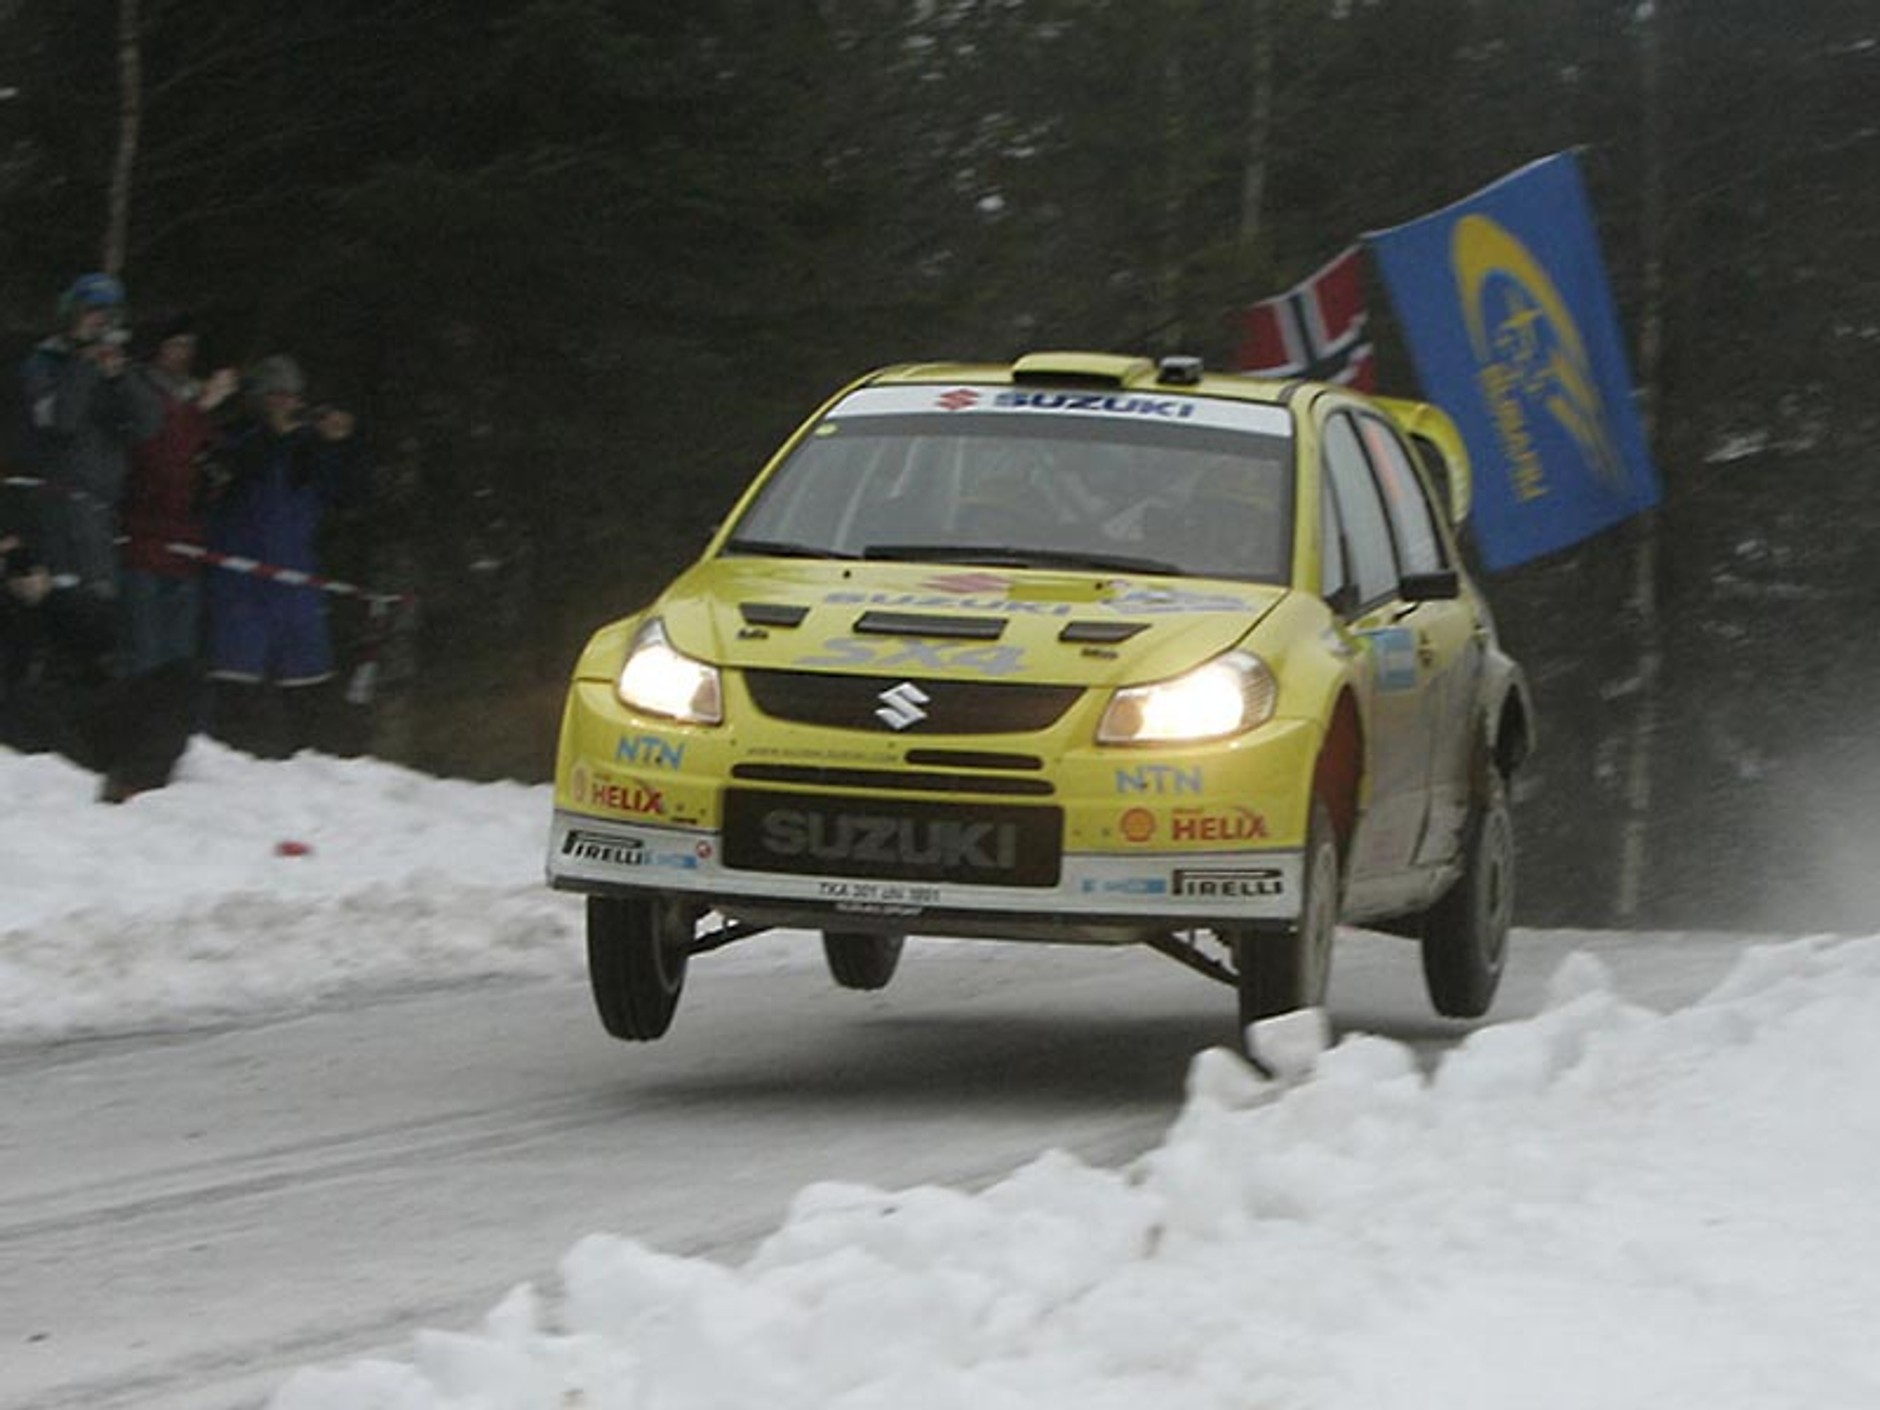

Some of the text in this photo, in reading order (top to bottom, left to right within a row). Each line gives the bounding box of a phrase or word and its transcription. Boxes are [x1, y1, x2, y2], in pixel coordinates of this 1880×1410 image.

[994, 391, 1195, 418] SUZUKI
[823, 592, 1070, 615] SUZUKI
[792, 635, 1031, 675] SX4
[615, 735, 686, 771] NTN
[592, 778, 667, 815] HELIX
[1116, 765, 1204, 795] NTN
[760, 807, 1017, 869] SUZUKI
[1172, 807, 1269, 841] HELIX
[562, 829, 643, 866] PIRELLI
[1171, 868, 1285, 897] PIRELLI
